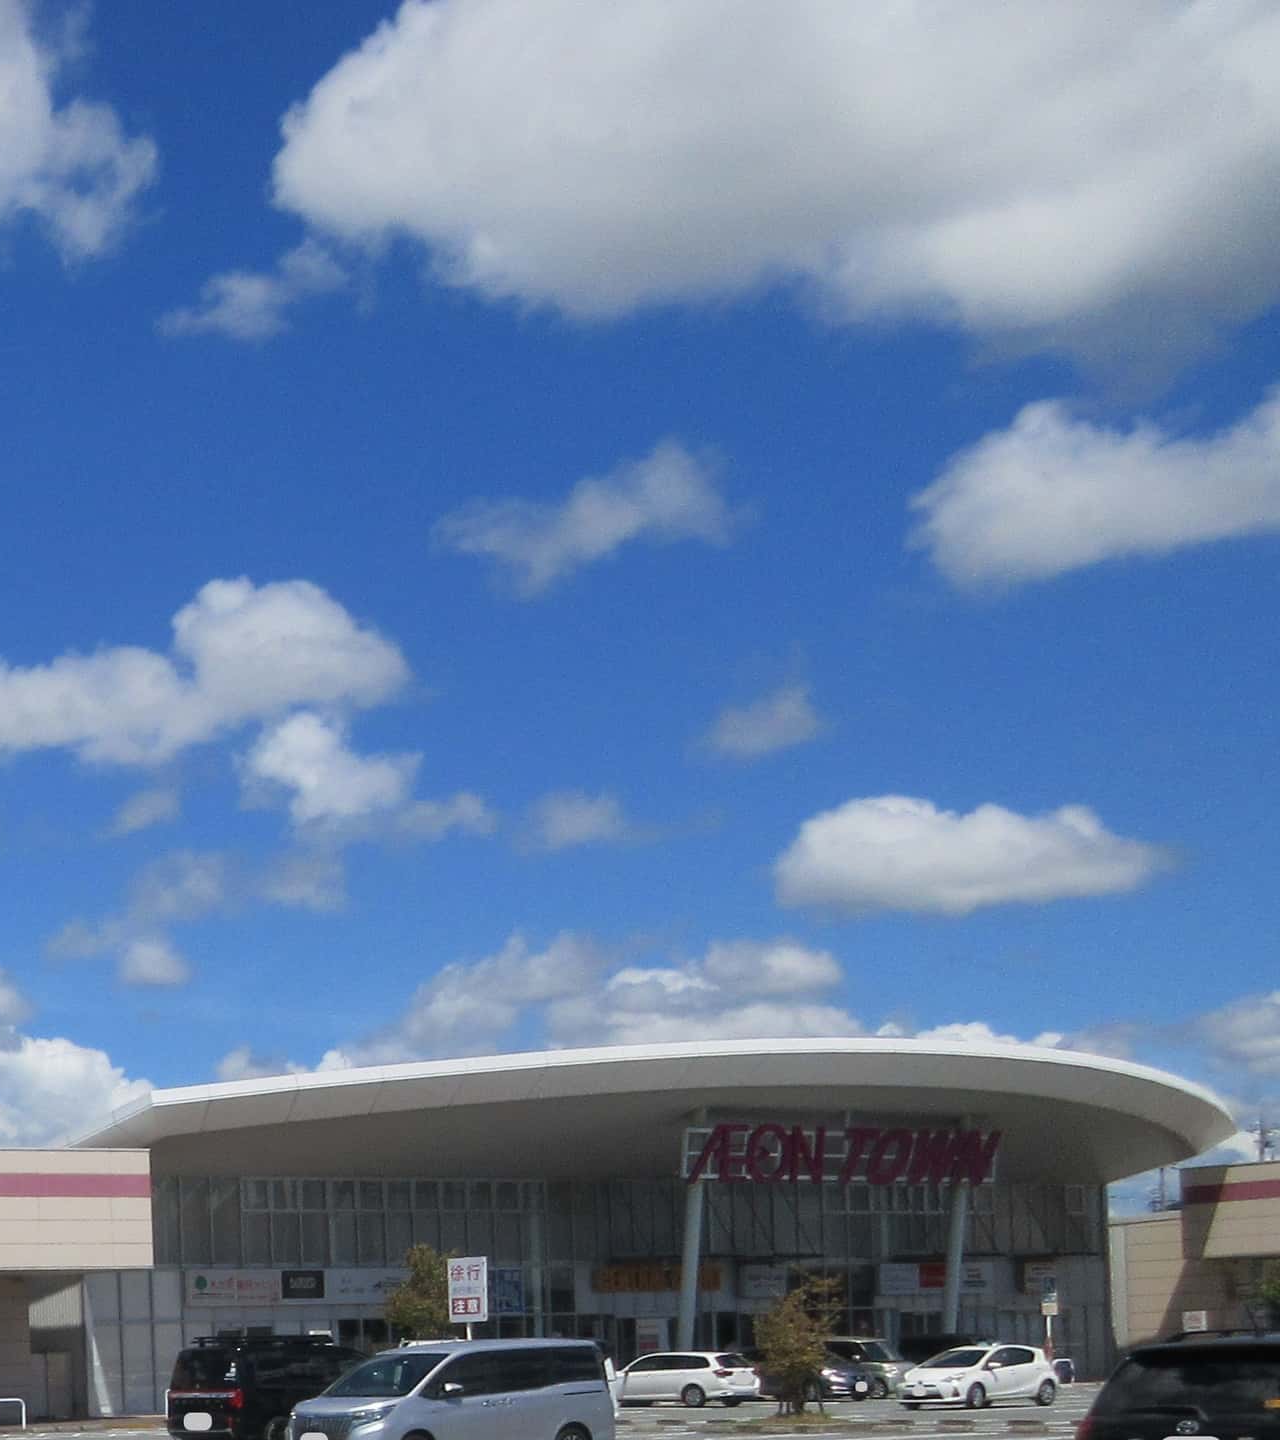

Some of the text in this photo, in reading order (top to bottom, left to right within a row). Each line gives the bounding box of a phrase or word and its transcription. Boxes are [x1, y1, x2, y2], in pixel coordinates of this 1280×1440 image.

[842, 1126, 1002, 1186] TOWN
[450, 1264, 481, 1282] 徐行
[453, 1299, 479, 1314] 注意
